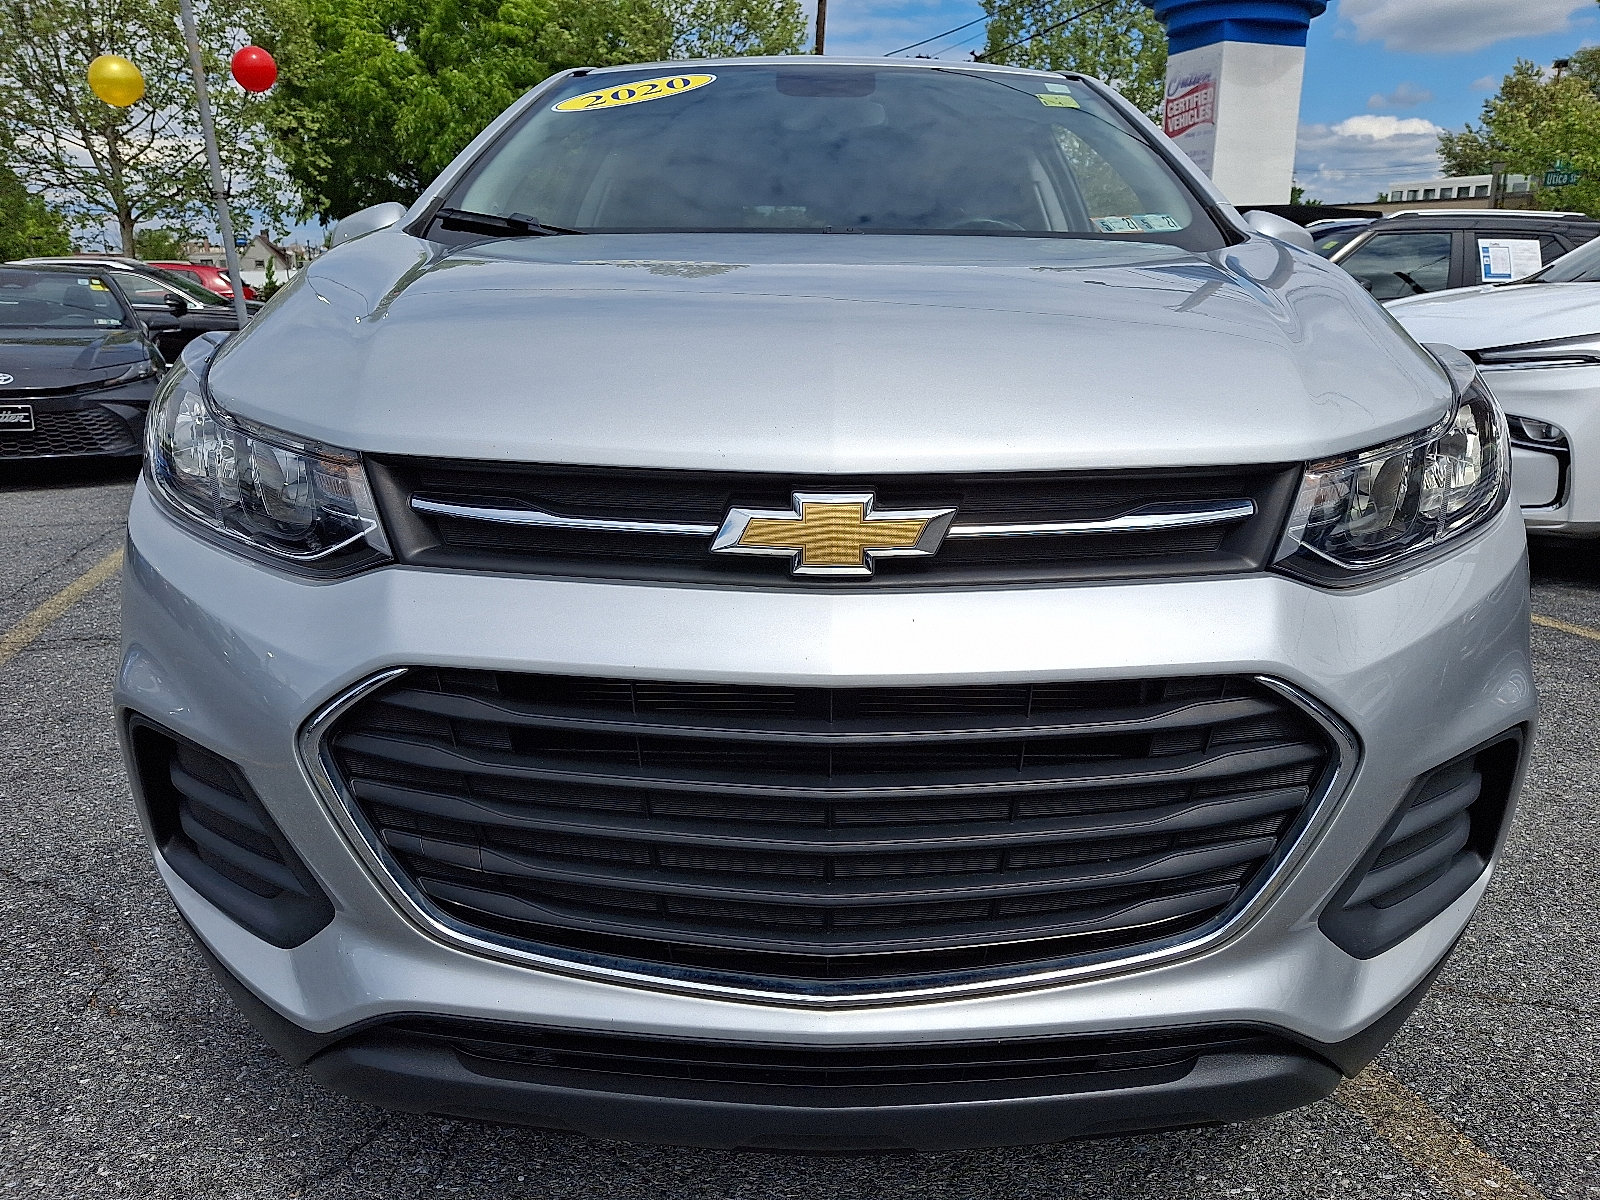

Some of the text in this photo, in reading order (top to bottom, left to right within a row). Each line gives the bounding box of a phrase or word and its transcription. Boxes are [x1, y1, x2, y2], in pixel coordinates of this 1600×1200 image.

[580, 77, 691, 108] 2020
[1167, 87, 1214, 117] CERTIFIED
[1168, 104, 1212, 132] VEHICLES
[1547, 173, 1568, 185] Utica
